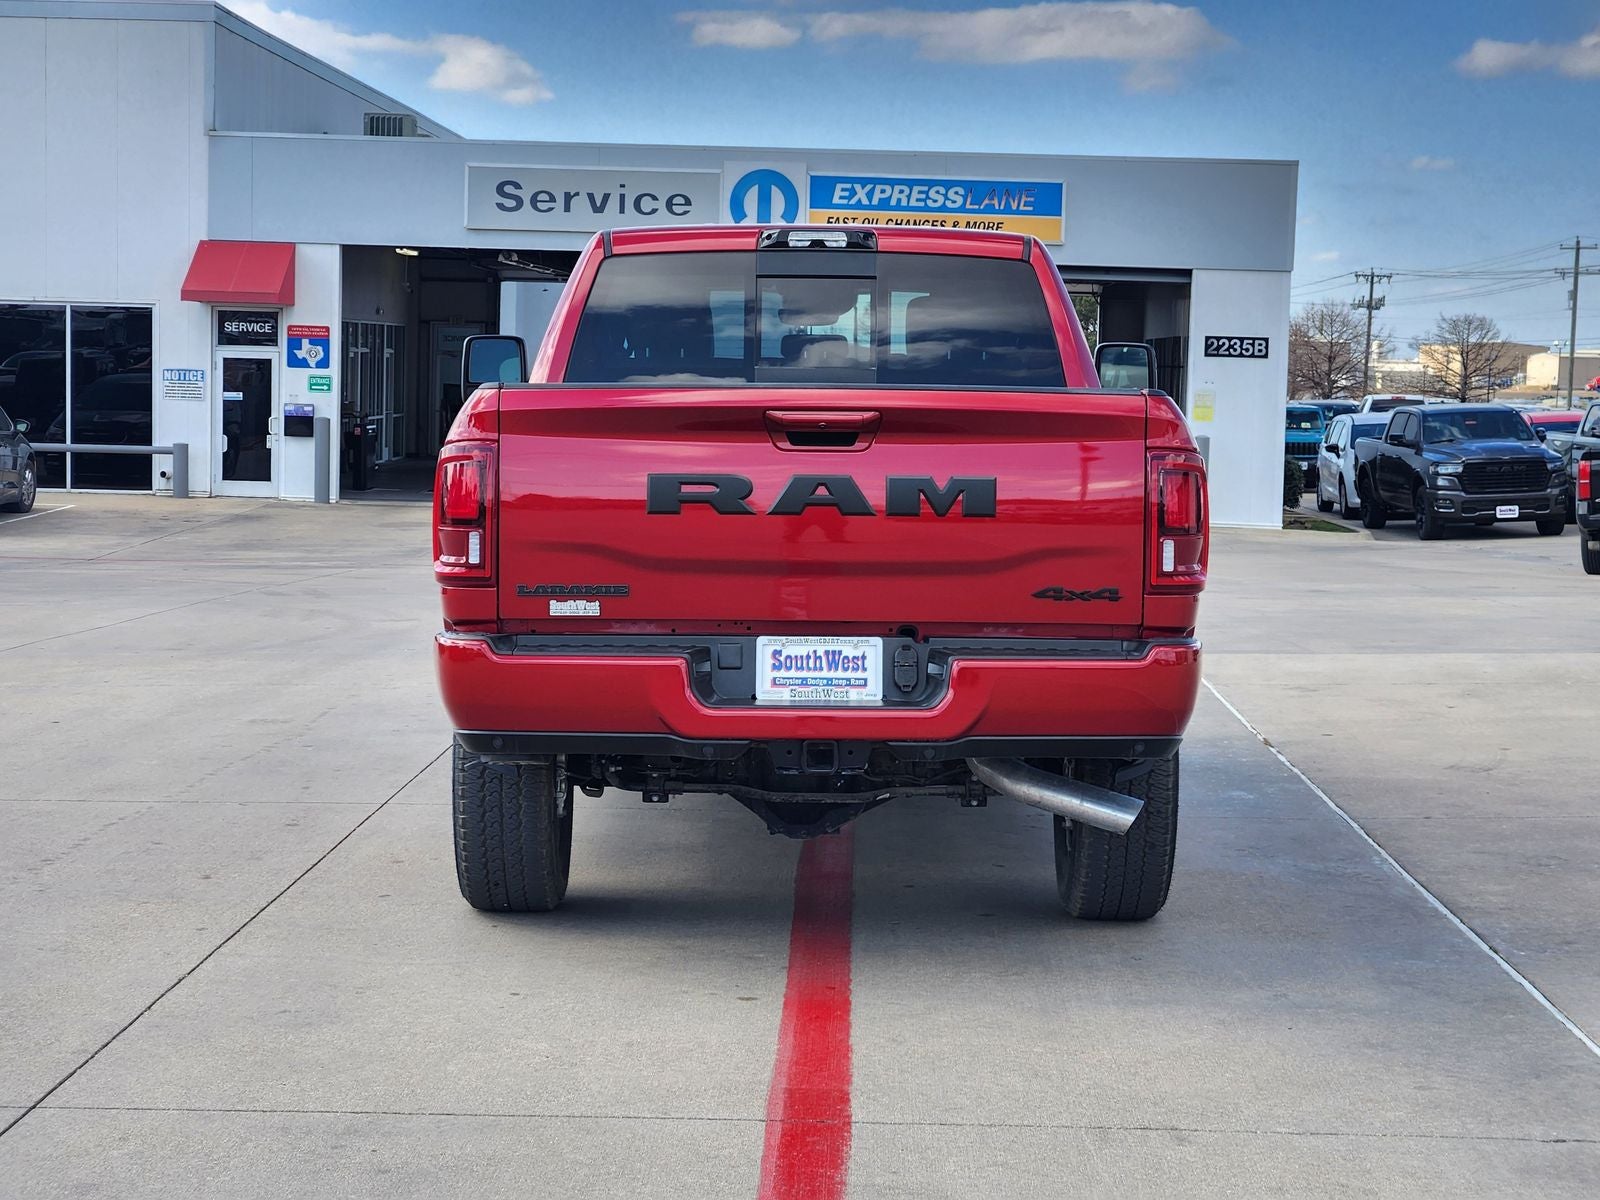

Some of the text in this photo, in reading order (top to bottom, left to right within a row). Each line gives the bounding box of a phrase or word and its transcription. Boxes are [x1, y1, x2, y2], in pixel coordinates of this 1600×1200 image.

[495, 179, 693, 217] Service
[224, 321, 273, 333] SERVICE
[1207, 338, 1267, 356] 2235B
[163, 370, 203, 381] NOTICE
[647, 473, 997, 518] RAM
[516, 584, 629, 596] LARAMIE
[771, 649, 868, 673] SouthWest
[775, 678, 802, 686] Chrysler
[807, 678, 827, 687] Dodge
[850, 678, 865, 686] Ram
[790, 688, 849, 699] SouthWest
